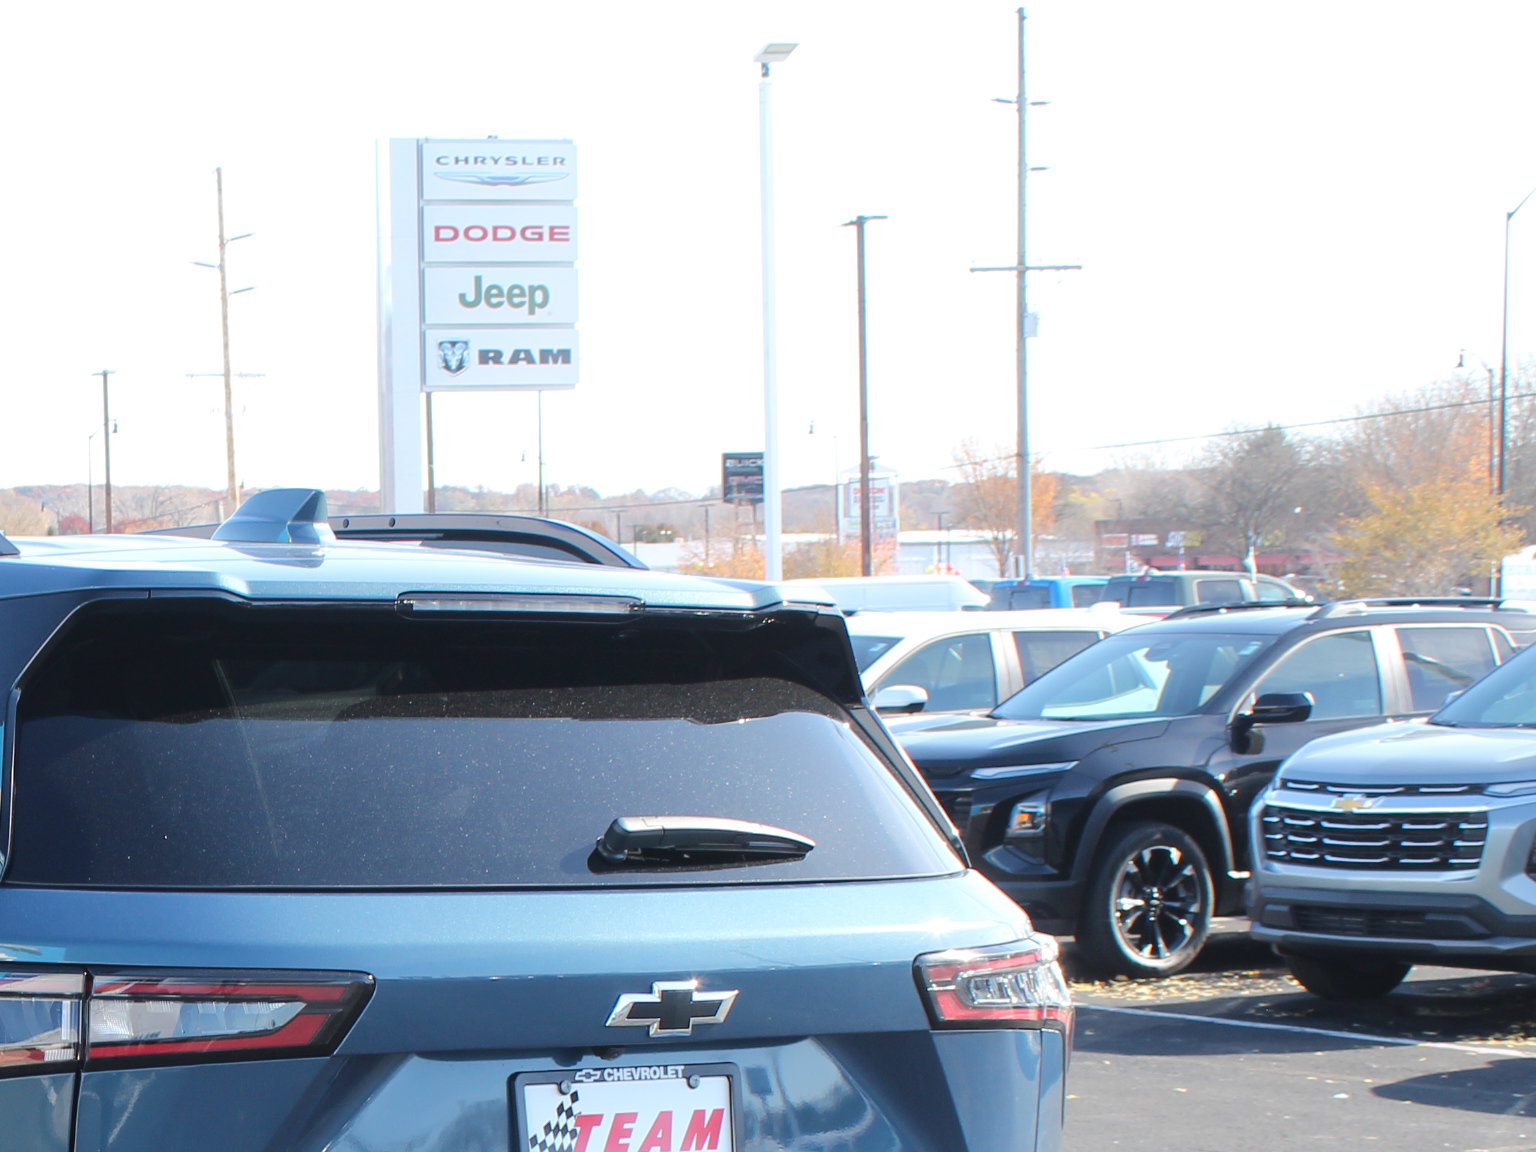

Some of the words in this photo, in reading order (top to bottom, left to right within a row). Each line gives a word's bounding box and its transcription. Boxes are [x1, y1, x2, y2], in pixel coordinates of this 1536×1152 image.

[435, 155, 567, 167] CHRYSLER
[433, 225, 571, 242] DODGE
[458, 275, 551, 316] Jeep
[478, 348, 572, 365] RAM
[603, 1065, 685, 1082] CHEVROLET
